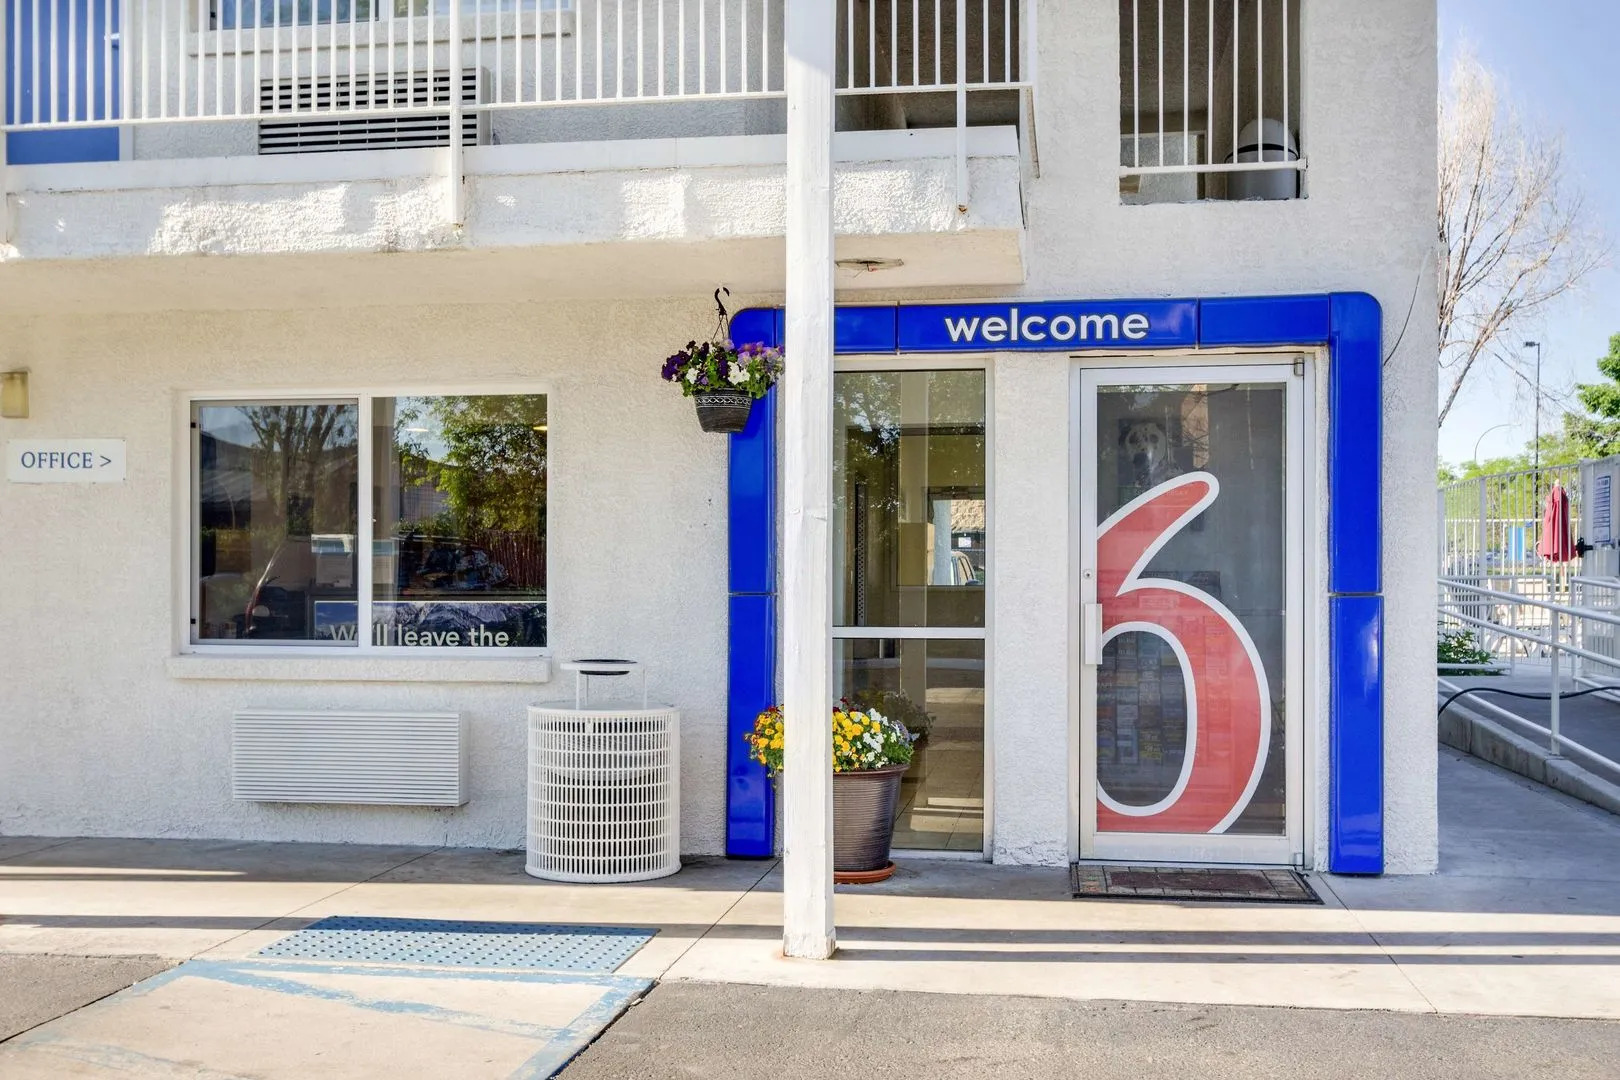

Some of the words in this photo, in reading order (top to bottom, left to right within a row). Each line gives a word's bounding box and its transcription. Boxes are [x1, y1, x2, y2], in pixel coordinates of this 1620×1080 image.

[944, 307, 1149, 342] welcome
[21, 451, 93, 469] OFFICE
[329, 624, 388, 646] W'll
[398, 623, 460, 647] leave
[468, 623, 510, 647] the
